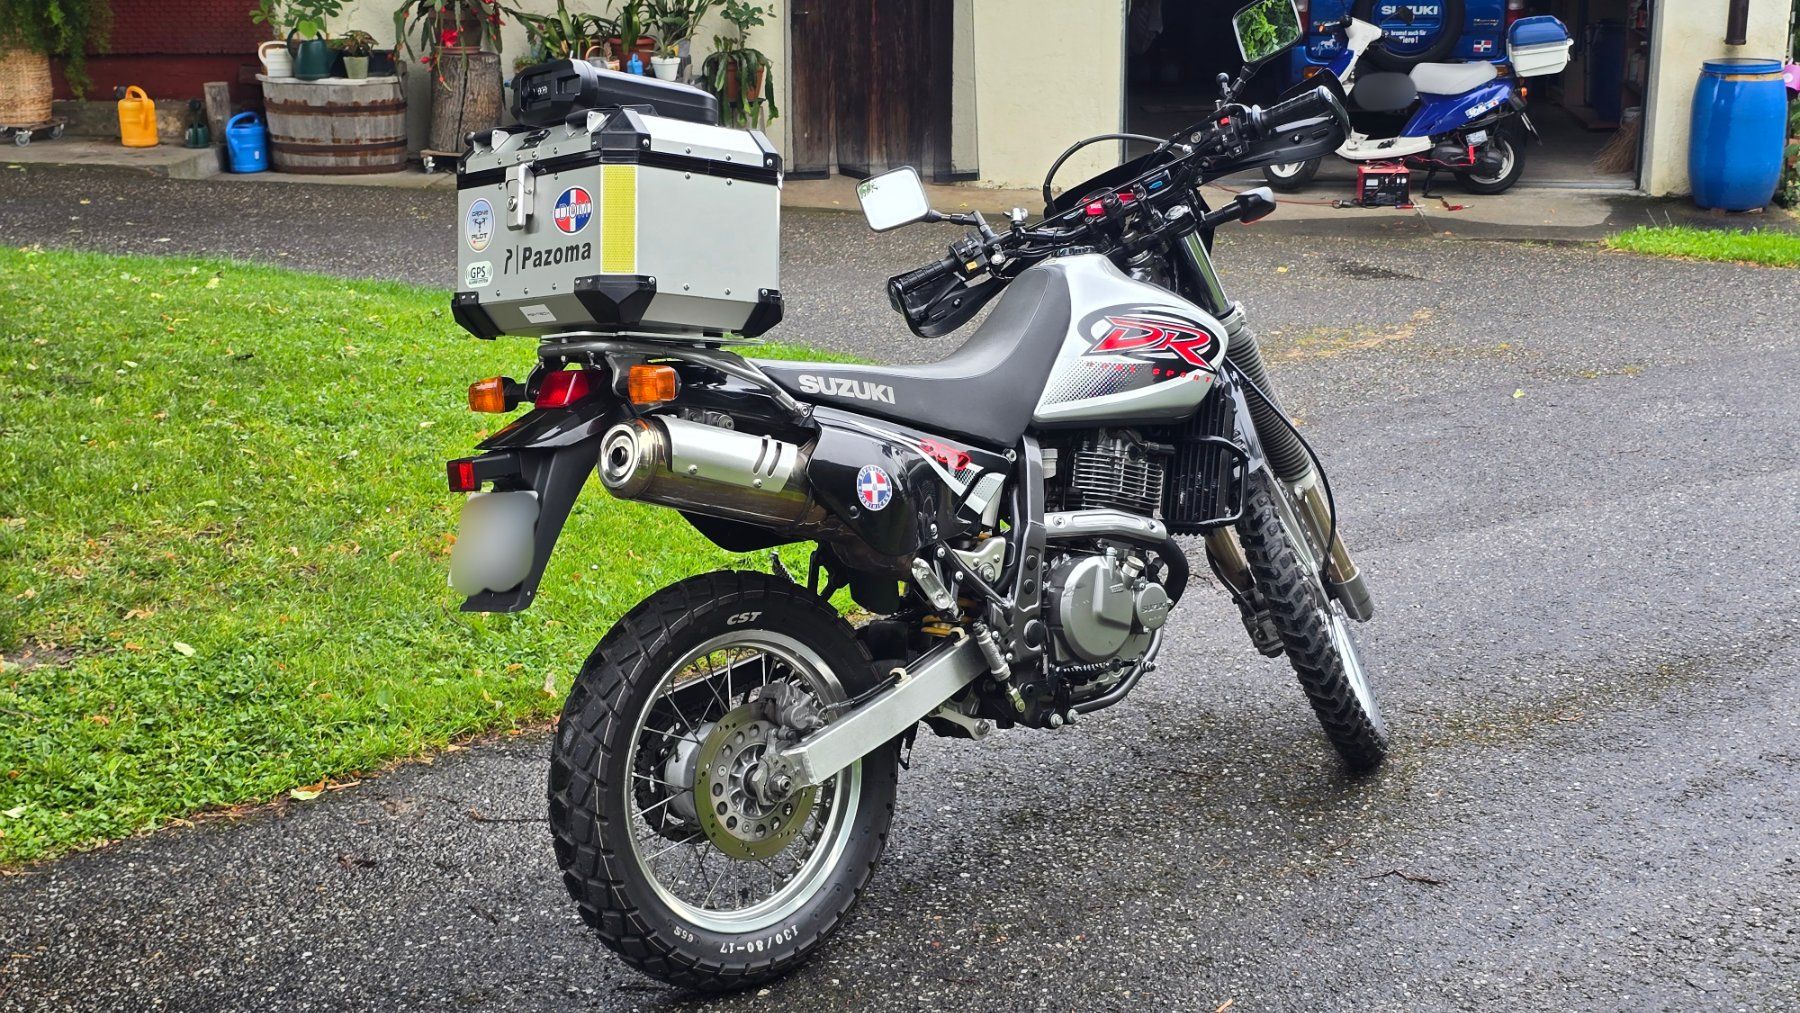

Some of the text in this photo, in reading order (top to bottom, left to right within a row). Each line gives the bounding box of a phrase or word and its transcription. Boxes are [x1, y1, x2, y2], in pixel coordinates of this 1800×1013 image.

[521, 242, 592, 270] Pazoma
[470, 266, 486, 279] GPS
[1086, 315, 1216, 373] DR
[798, 374, 896, 405] SUZUKI
[726, 611, 763, 626] CST
[719, 924, 799, 954] 130/80-17
